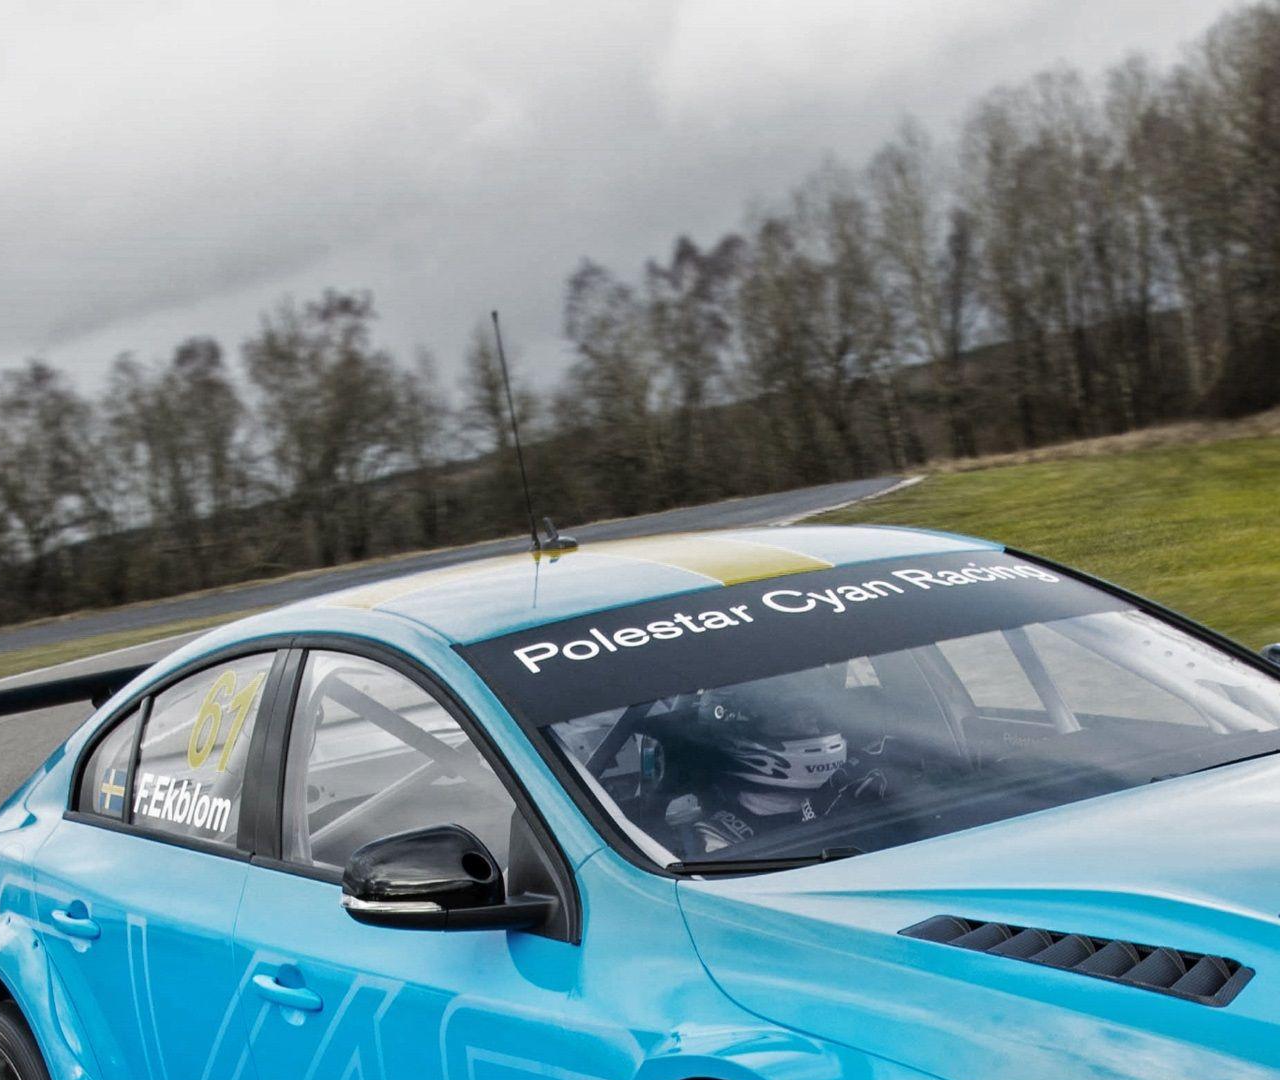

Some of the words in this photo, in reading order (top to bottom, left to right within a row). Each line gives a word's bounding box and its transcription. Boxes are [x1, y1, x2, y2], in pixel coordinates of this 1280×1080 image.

[513, 604, 754, 674] Polestar
[762, 578, 904, 613] Cyan
[892, 562, 1060, 590] Racing
[187, 670, 267, 773] 61
[133, 772, 231, 832] F.Ekblom
